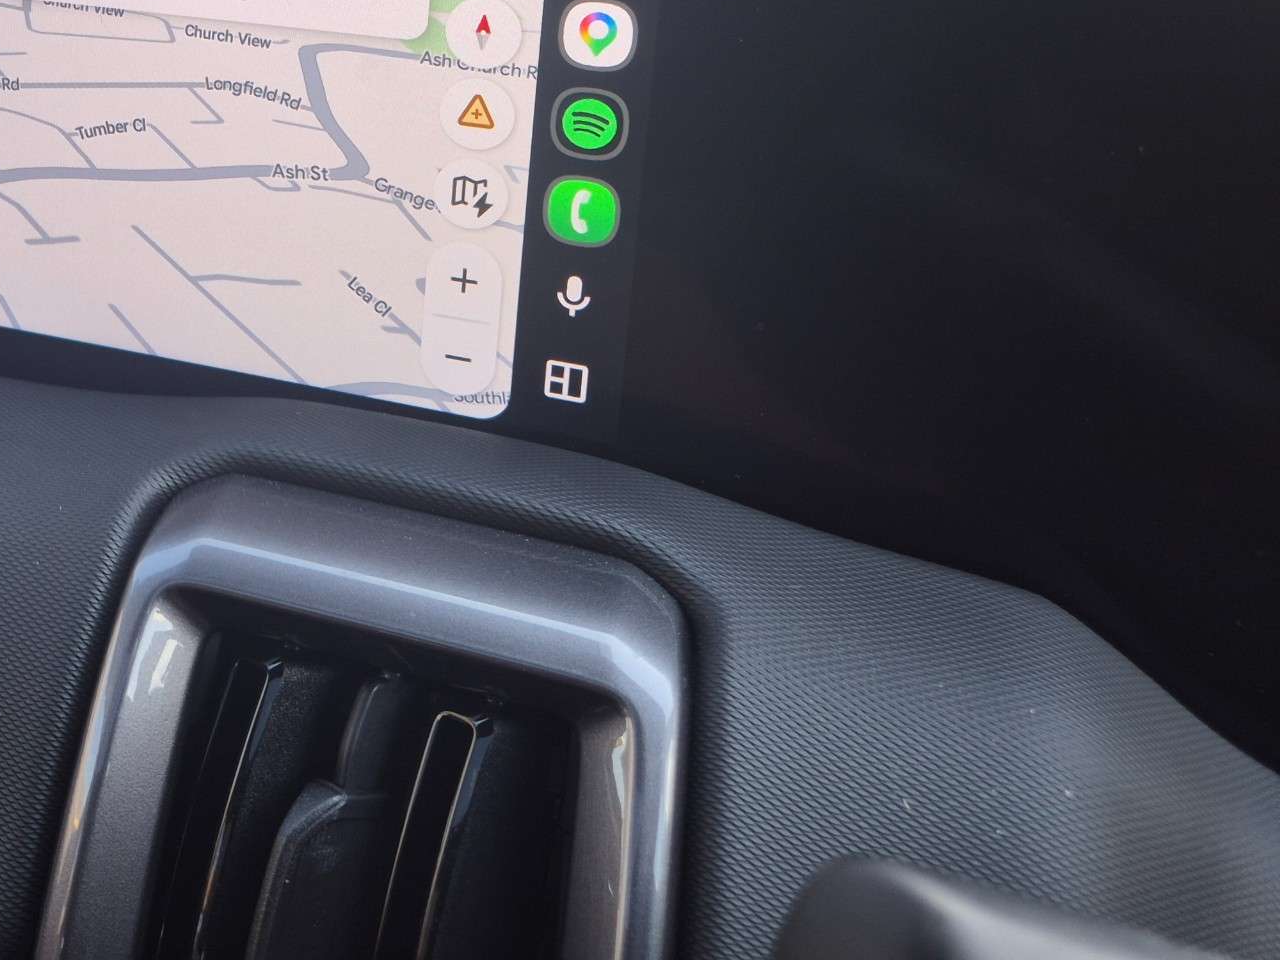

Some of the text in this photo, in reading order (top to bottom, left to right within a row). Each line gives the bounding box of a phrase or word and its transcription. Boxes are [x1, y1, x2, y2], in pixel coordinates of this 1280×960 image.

[184, 24, 272, 49] Church View
[419, 51, 452, 68] Ash
[457, 58, 521, 78] Crch
[1, 77, 20, 91] Rd
[205, 76, 302, 111] Longfield Rd
[75, 118, 147, 141] Tumber Cl
[272, 163, 329, 182] Ash St
[374, 176, 436, 211] Grange
[347, 276, 393, 318] Lea Cl
